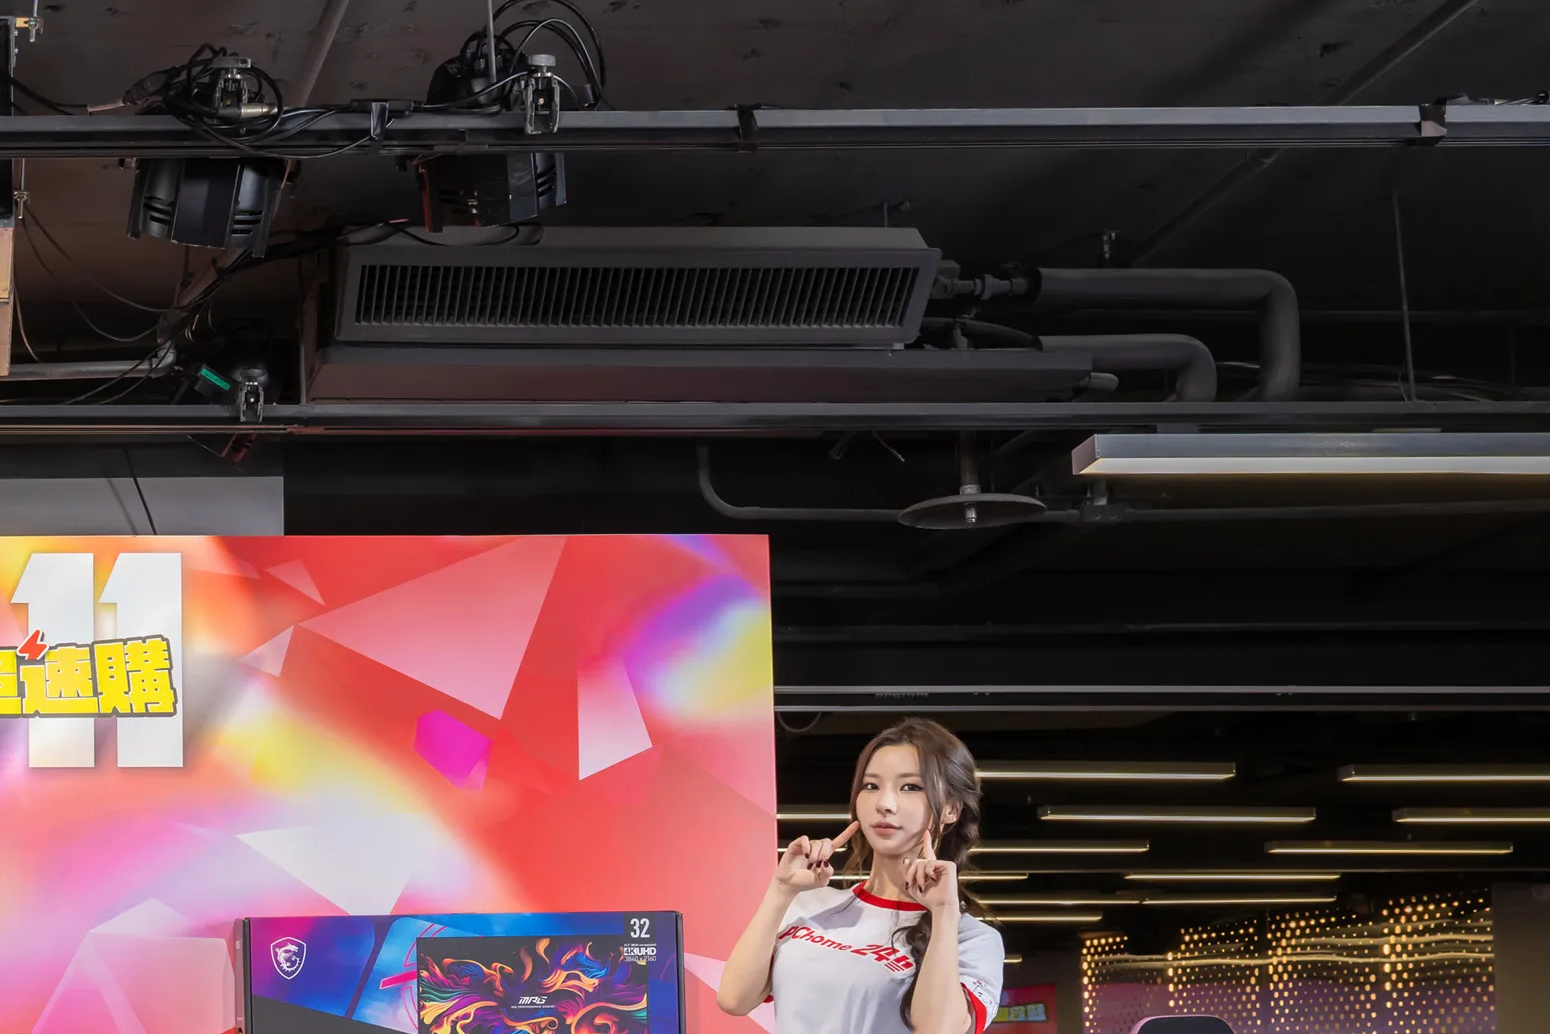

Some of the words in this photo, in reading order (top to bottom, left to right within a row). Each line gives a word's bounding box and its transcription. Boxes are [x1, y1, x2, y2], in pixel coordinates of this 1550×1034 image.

[630, 918, 650, 938] 32
[778, 926, 852, 951] PChome
[850, 944, 914, 973] 24h
[518, 996, 548, 1004] MPG
